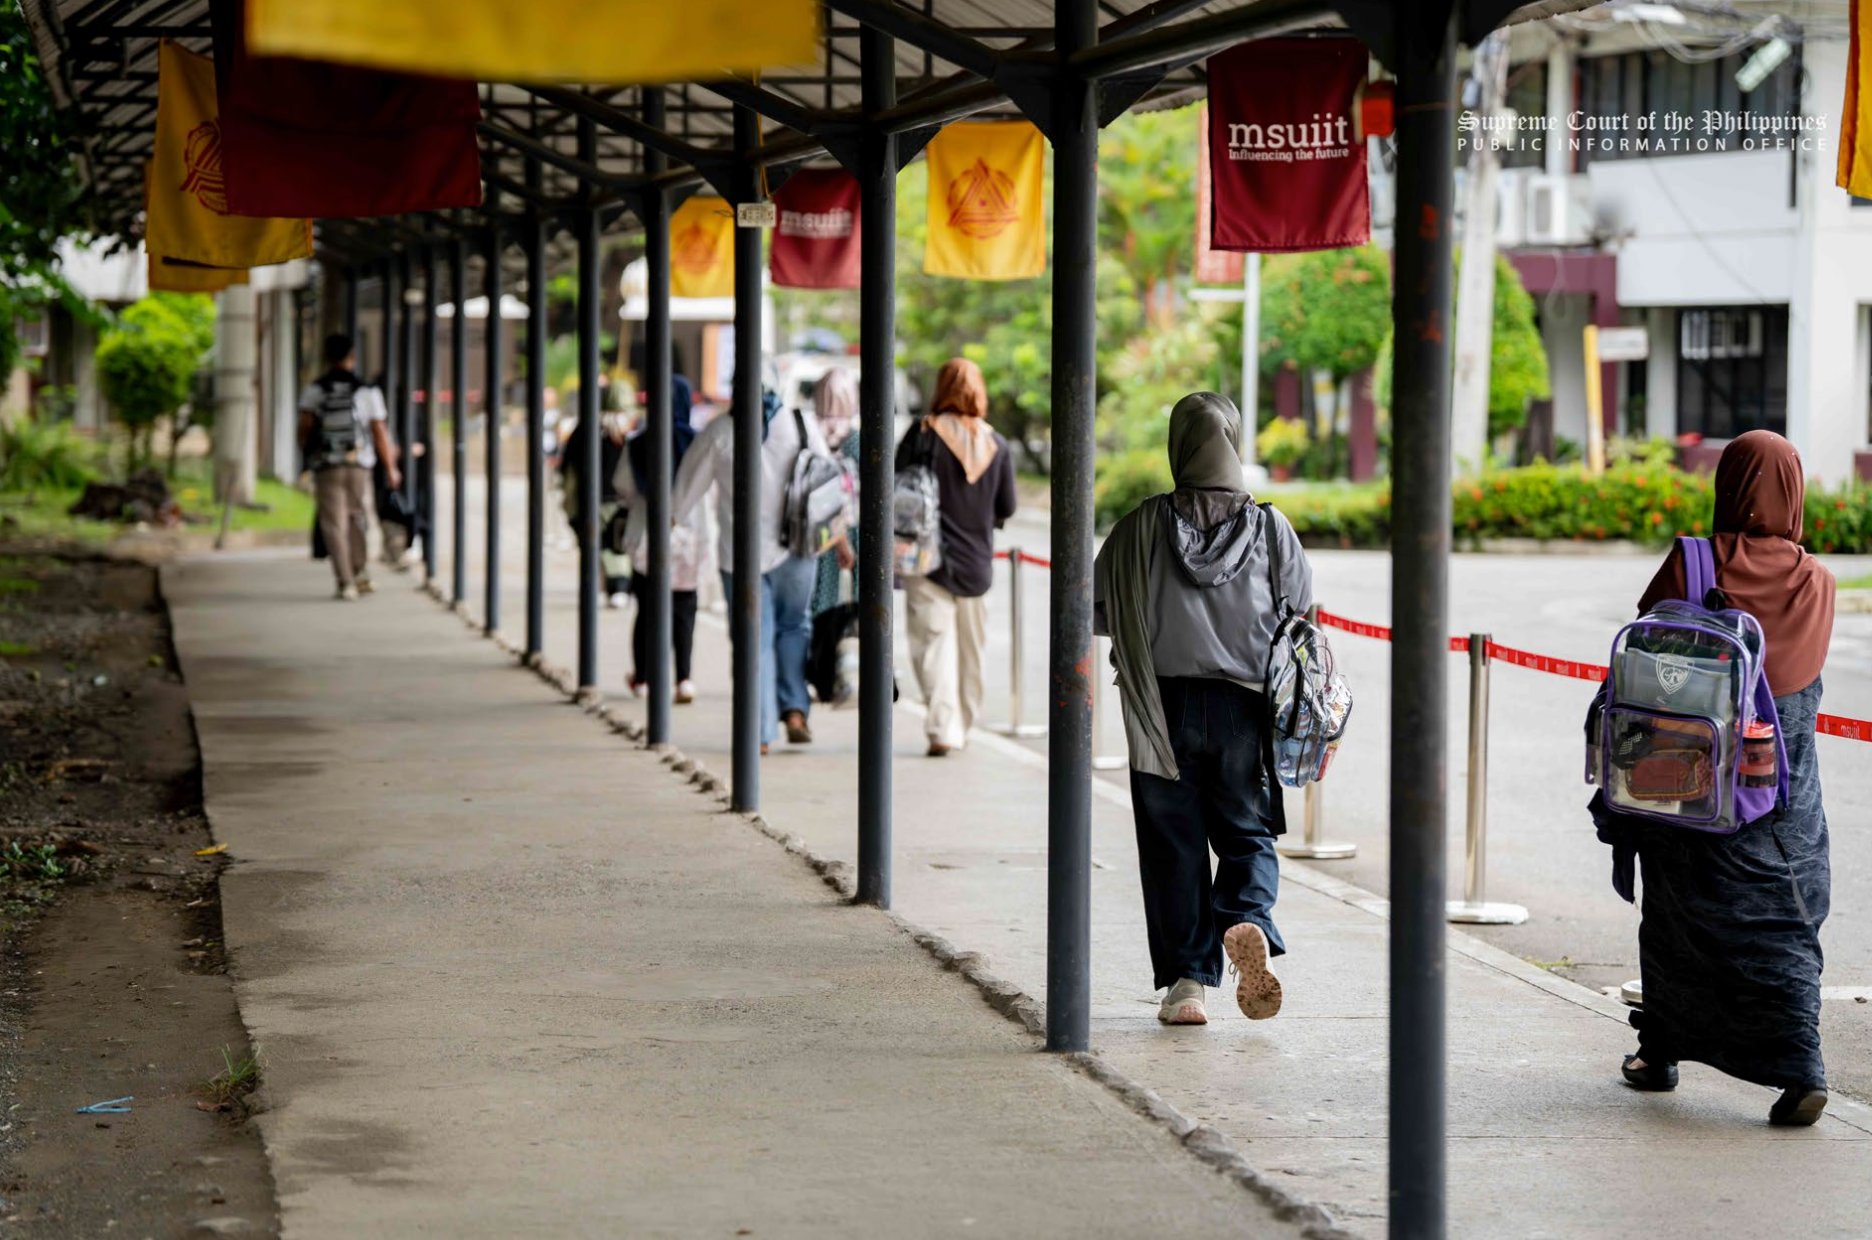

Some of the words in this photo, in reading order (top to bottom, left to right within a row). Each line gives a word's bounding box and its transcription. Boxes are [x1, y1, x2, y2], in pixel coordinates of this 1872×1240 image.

[1228, 112, 1349, 149] msuiit
[1228, 148, 1293, 162] Influencing
[1295, 148, 1314, 160] the
[1315, 147, 1349, 159] future
